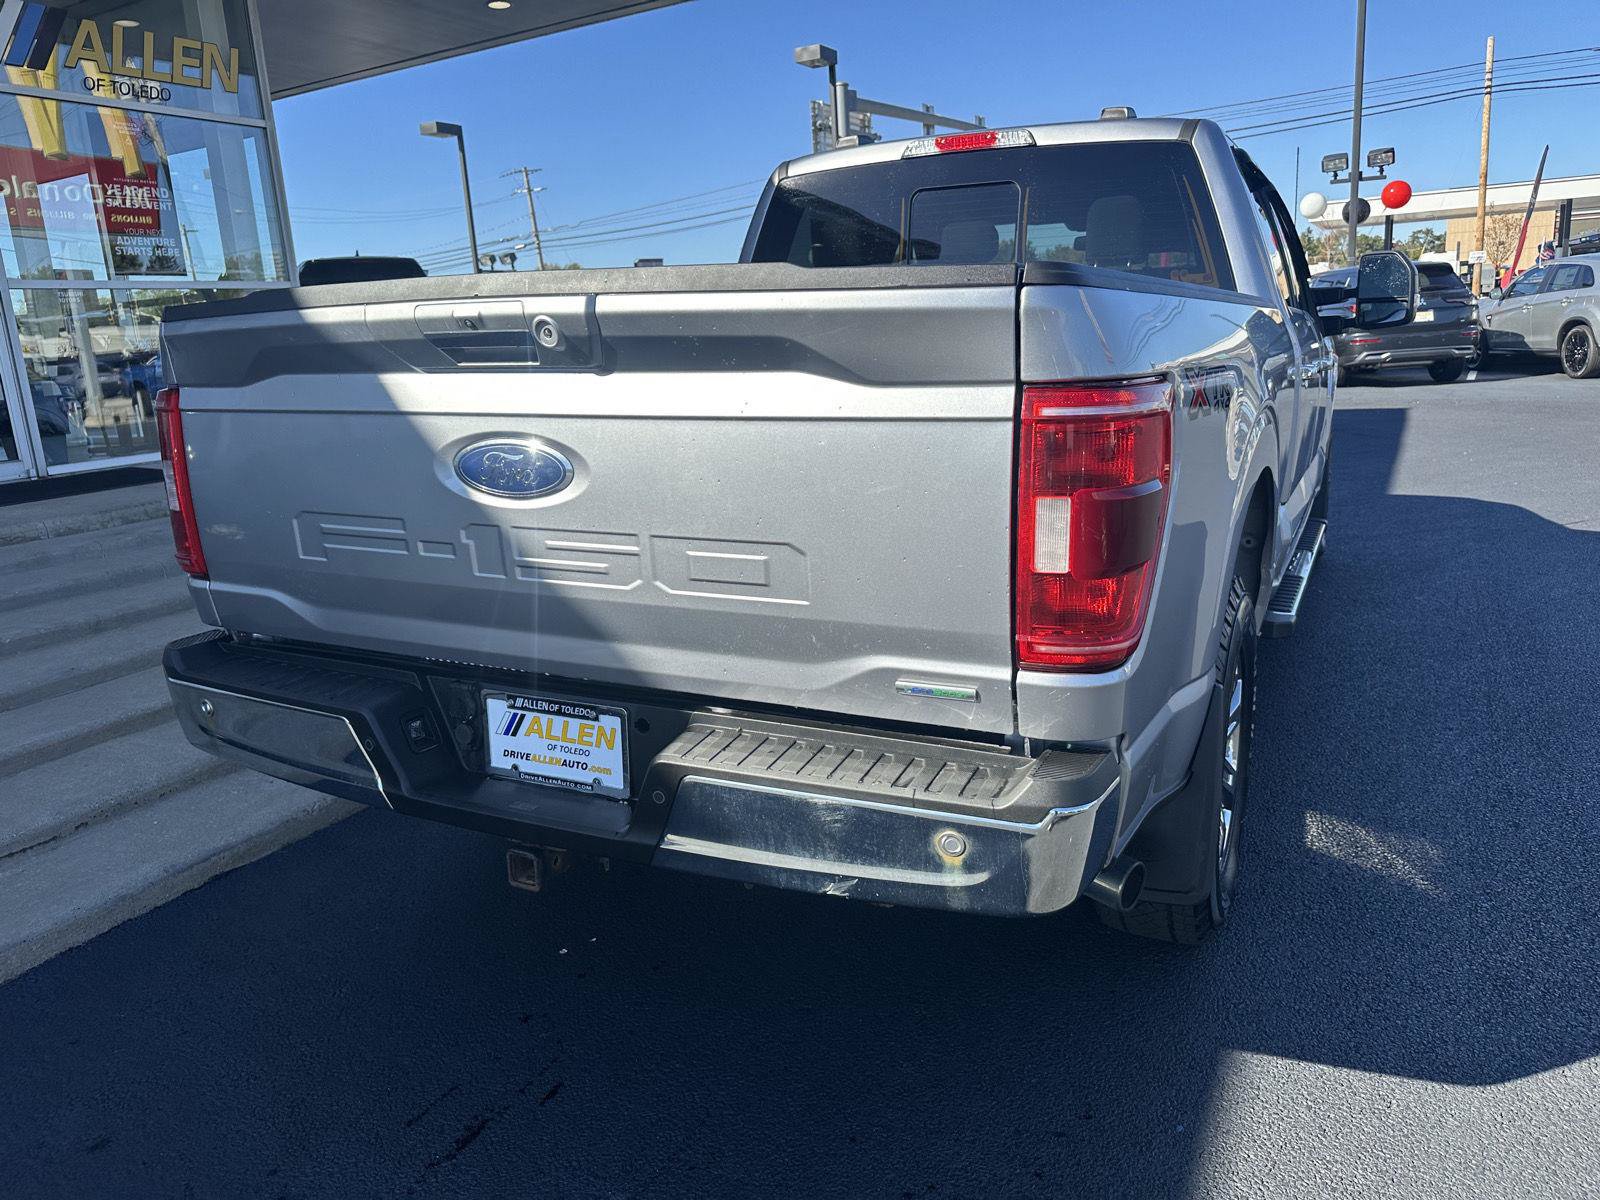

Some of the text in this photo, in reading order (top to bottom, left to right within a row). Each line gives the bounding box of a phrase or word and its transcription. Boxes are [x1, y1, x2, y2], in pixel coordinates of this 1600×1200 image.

[64, 19, 239, 93] ALLEN
[83, 76, 171, 101] OF TOLEDO
[105, 198, 172, 211] SALES EVENT
[116, 236, 176, 247] ADVENTURE
[124, 227, 145, 236] YOUR
[115, 246, 181, 257] STARTS HERE
[480, 451, 542, 487] Ford
[293, 510, 811, 605] F-150
[522, 698, 591, 717] ALLEN OF TOLEDO
[524, 715, 617, 750] ALLEN
[547, 743, 591, 757] OF TOLEDO
[502, 749, 612, 776] DRIVEALLENAUTO.com
